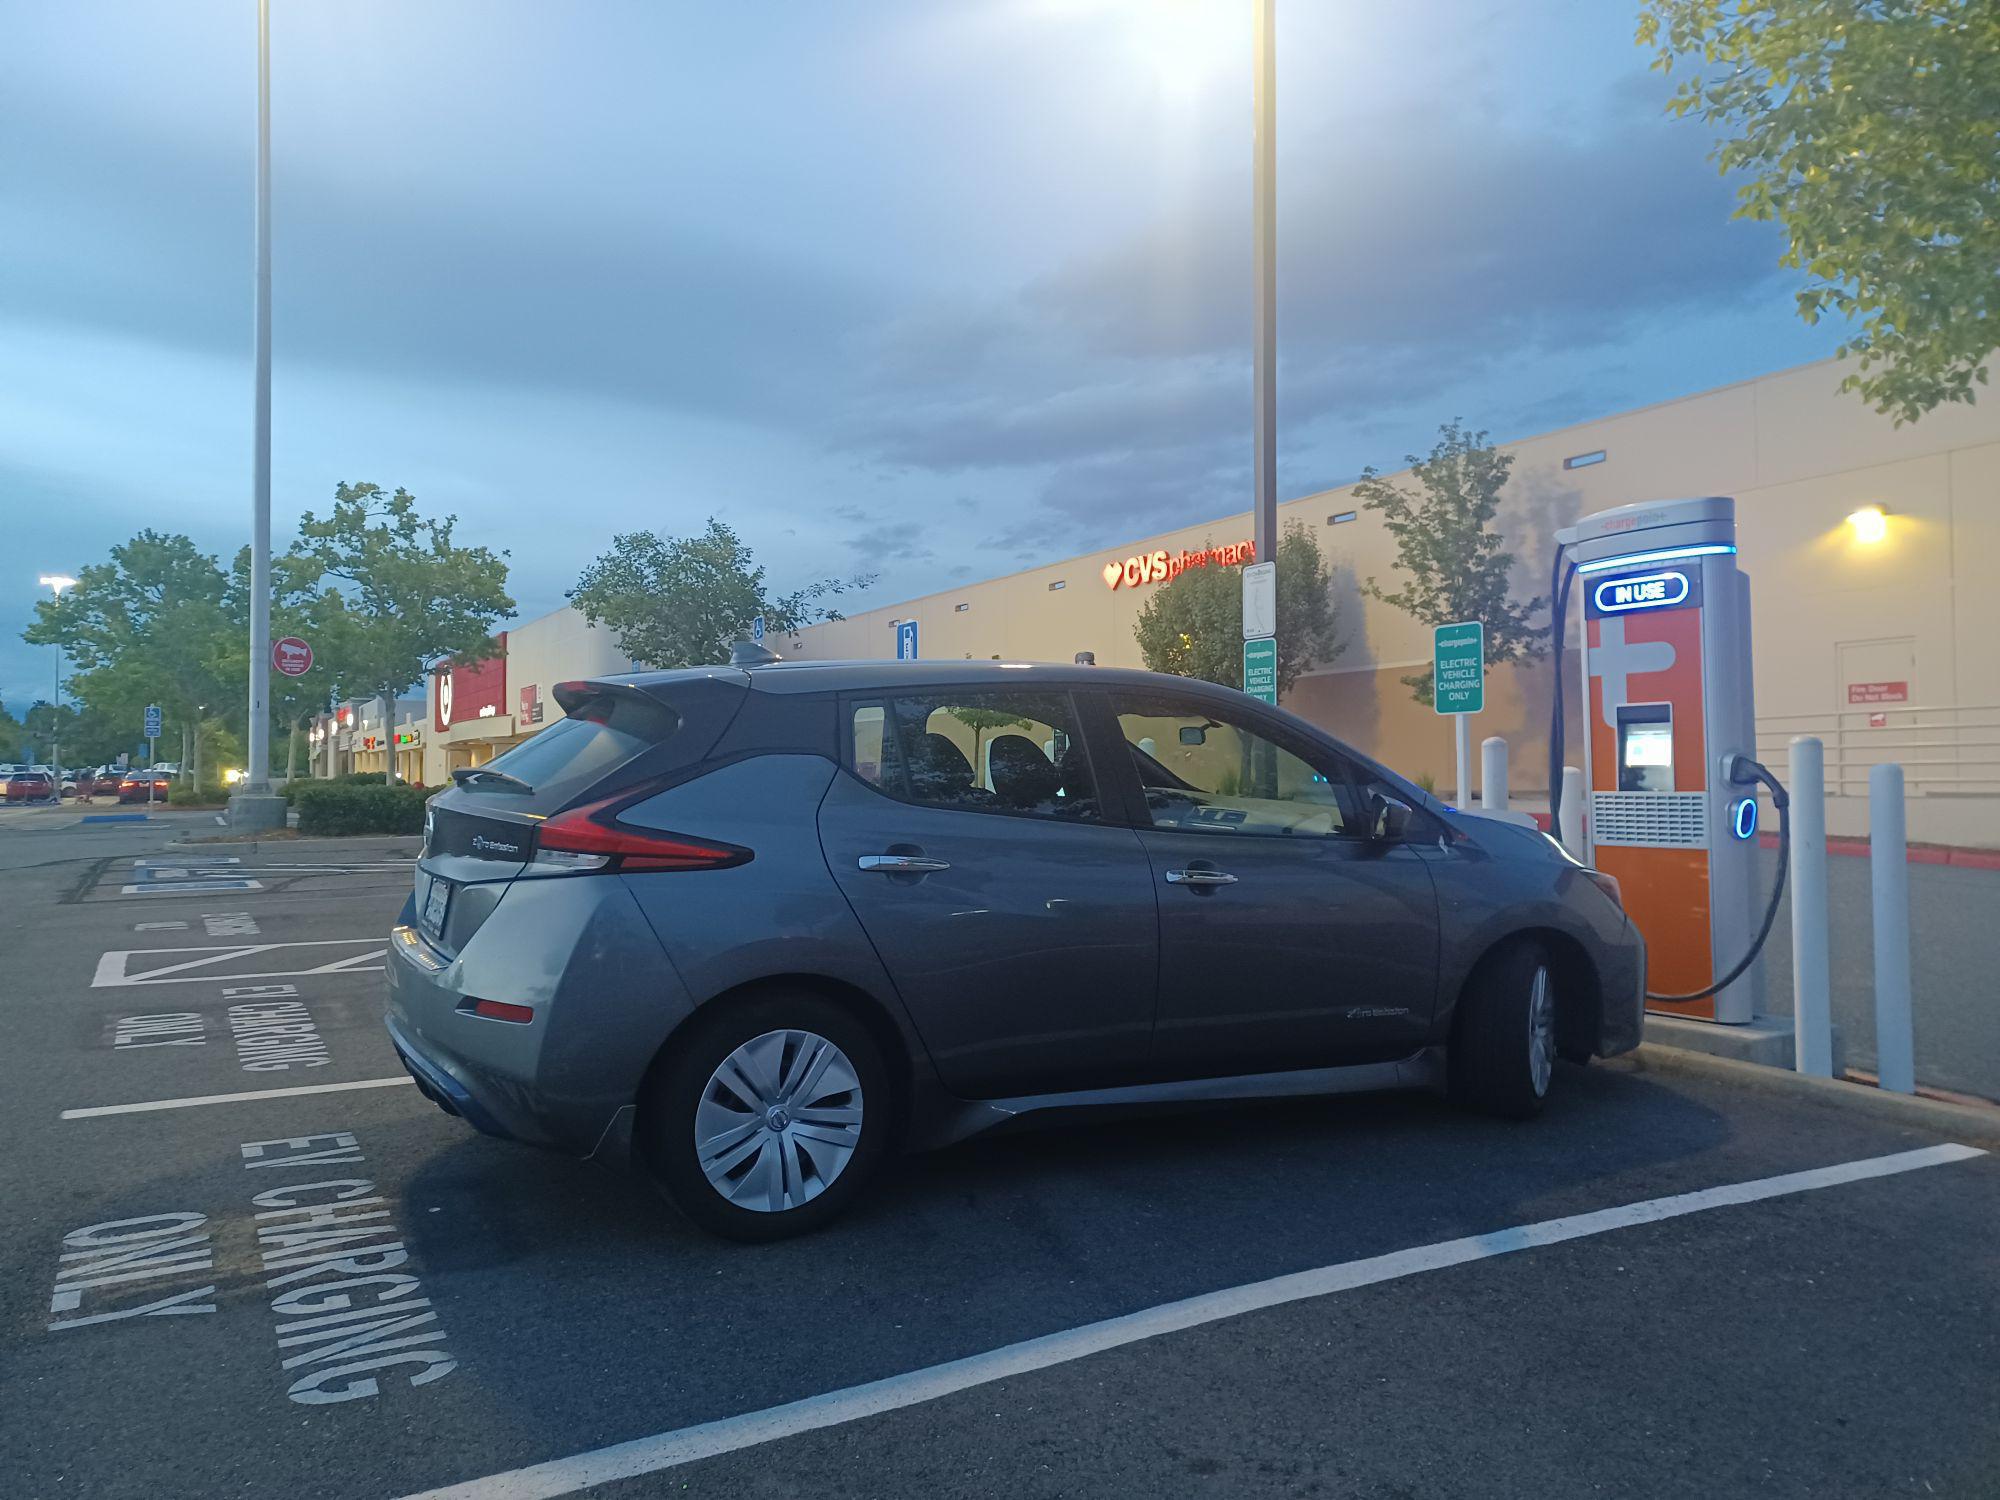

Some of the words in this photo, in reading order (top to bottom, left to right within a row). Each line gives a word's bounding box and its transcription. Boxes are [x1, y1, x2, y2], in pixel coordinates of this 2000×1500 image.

[1123, 550, 1169, 587] CVS
[1615, 585, 1632, 604] IN
[1633, 580, 1665, 601] USE
[1440, 658, 1477, 669] ELECTRIC
[1442, 669, 1475, 679] VEHICLE
[1439, 680, 1480, 691] CHARGING
[1448, 691, 1469, 701] ONLY
[222, 984, 299, 1000] EV
[114, 1012, 206, 1050] ONLY
[228, 1001, 333, 1072] CHARGING
[241, 1131, 366, 1169] EV
[48, 1212, 217, 1331] ONLY
[252, 1179, 459, 1405] CHARGING
